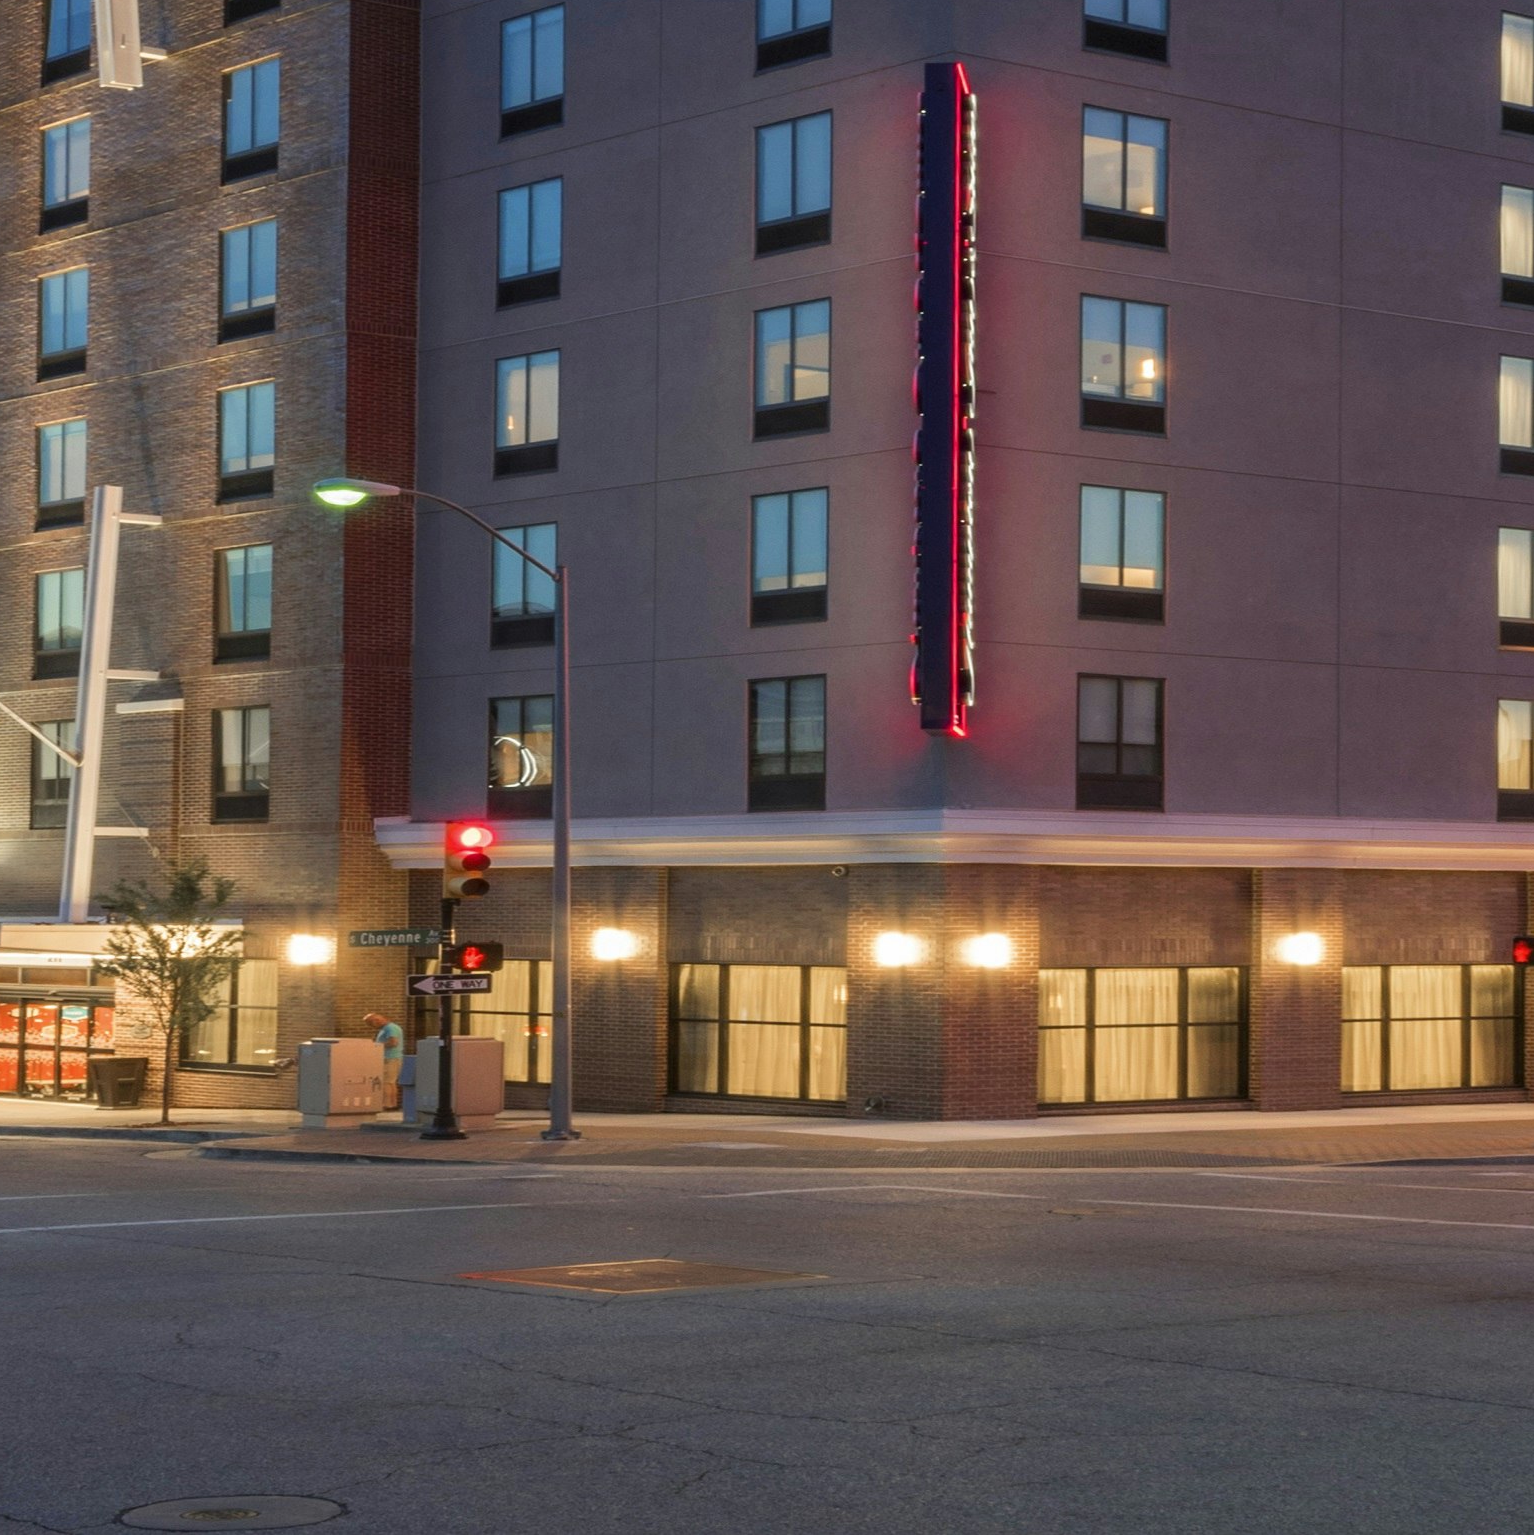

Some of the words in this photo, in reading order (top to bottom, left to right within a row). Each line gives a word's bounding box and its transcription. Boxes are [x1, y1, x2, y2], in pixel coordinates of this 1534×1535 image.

[360, 933, 421, 946] Cheyenne
[433, 980, 454, 989] ONE
[461, 979, 483, 988] WAY
